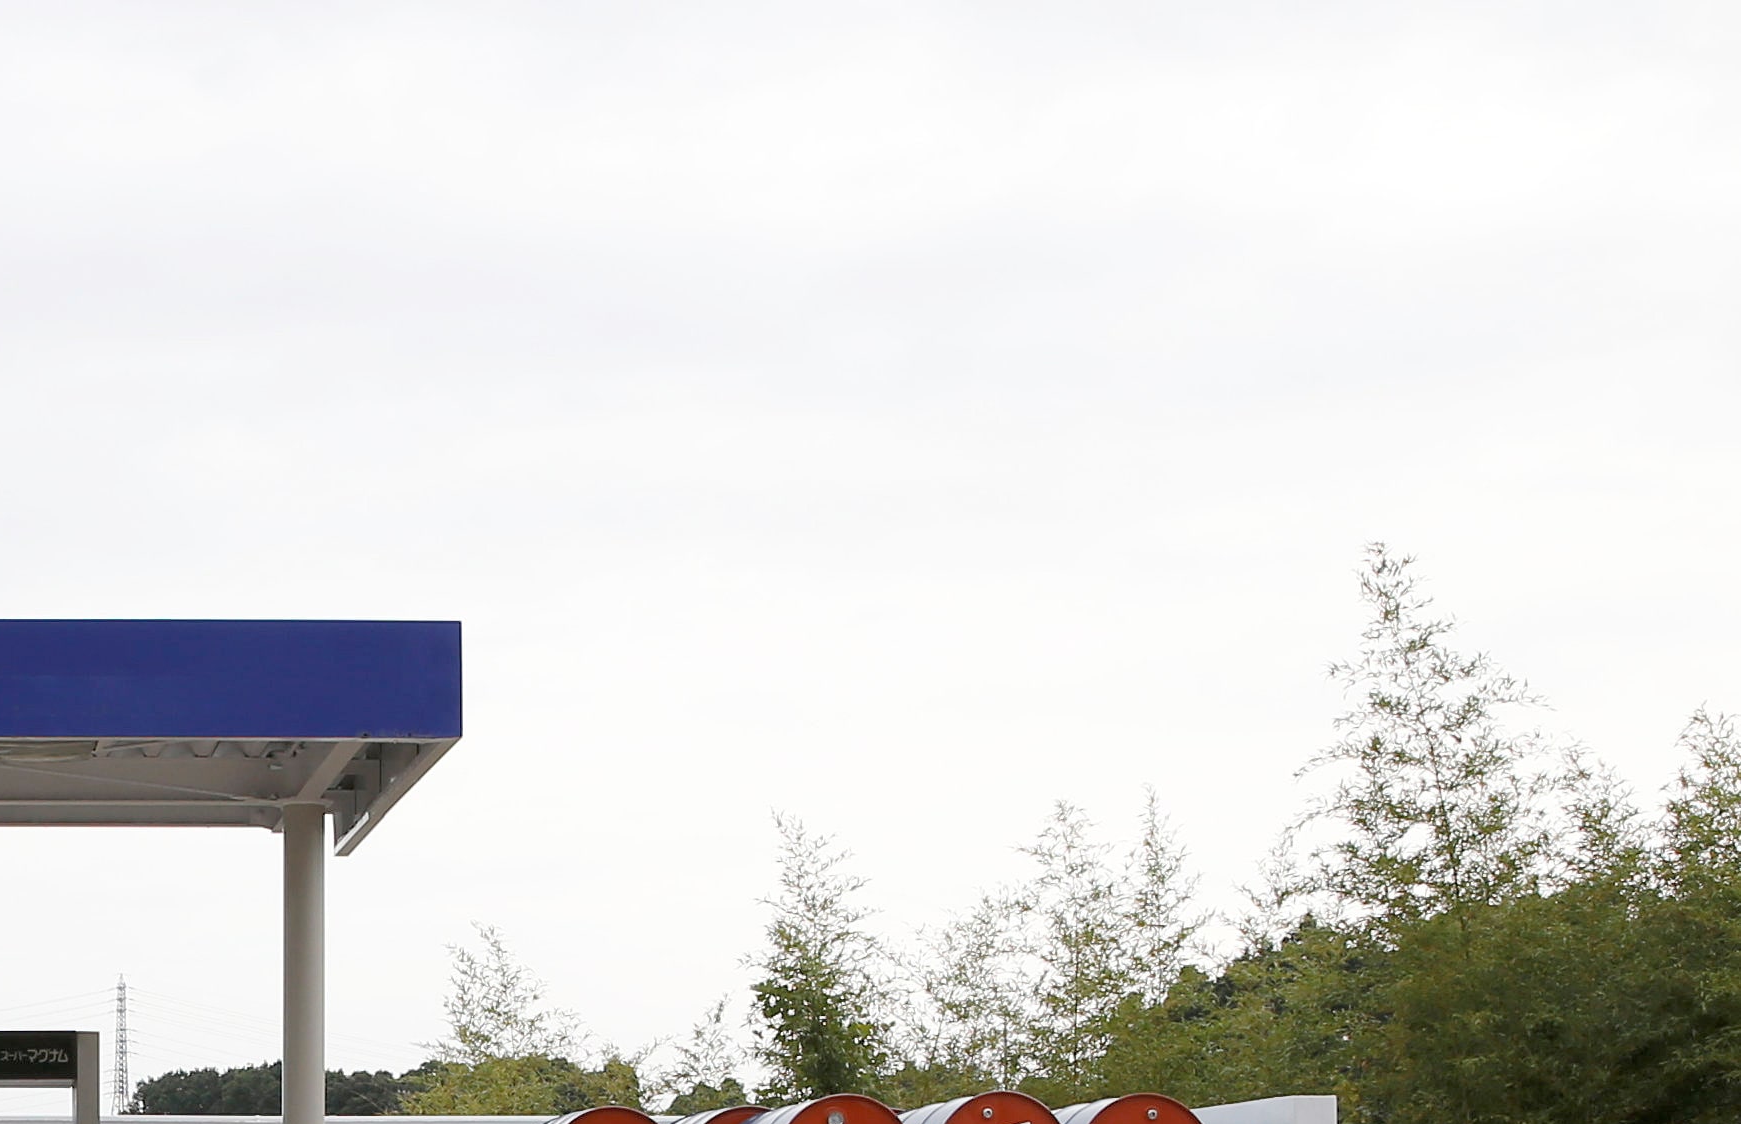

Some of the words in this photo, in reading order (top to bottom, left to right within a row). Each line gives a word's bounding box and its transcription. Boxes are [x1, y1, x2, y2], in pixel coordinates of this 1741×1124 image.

[0, 1050, 69, 1063] スーパーマグナム
